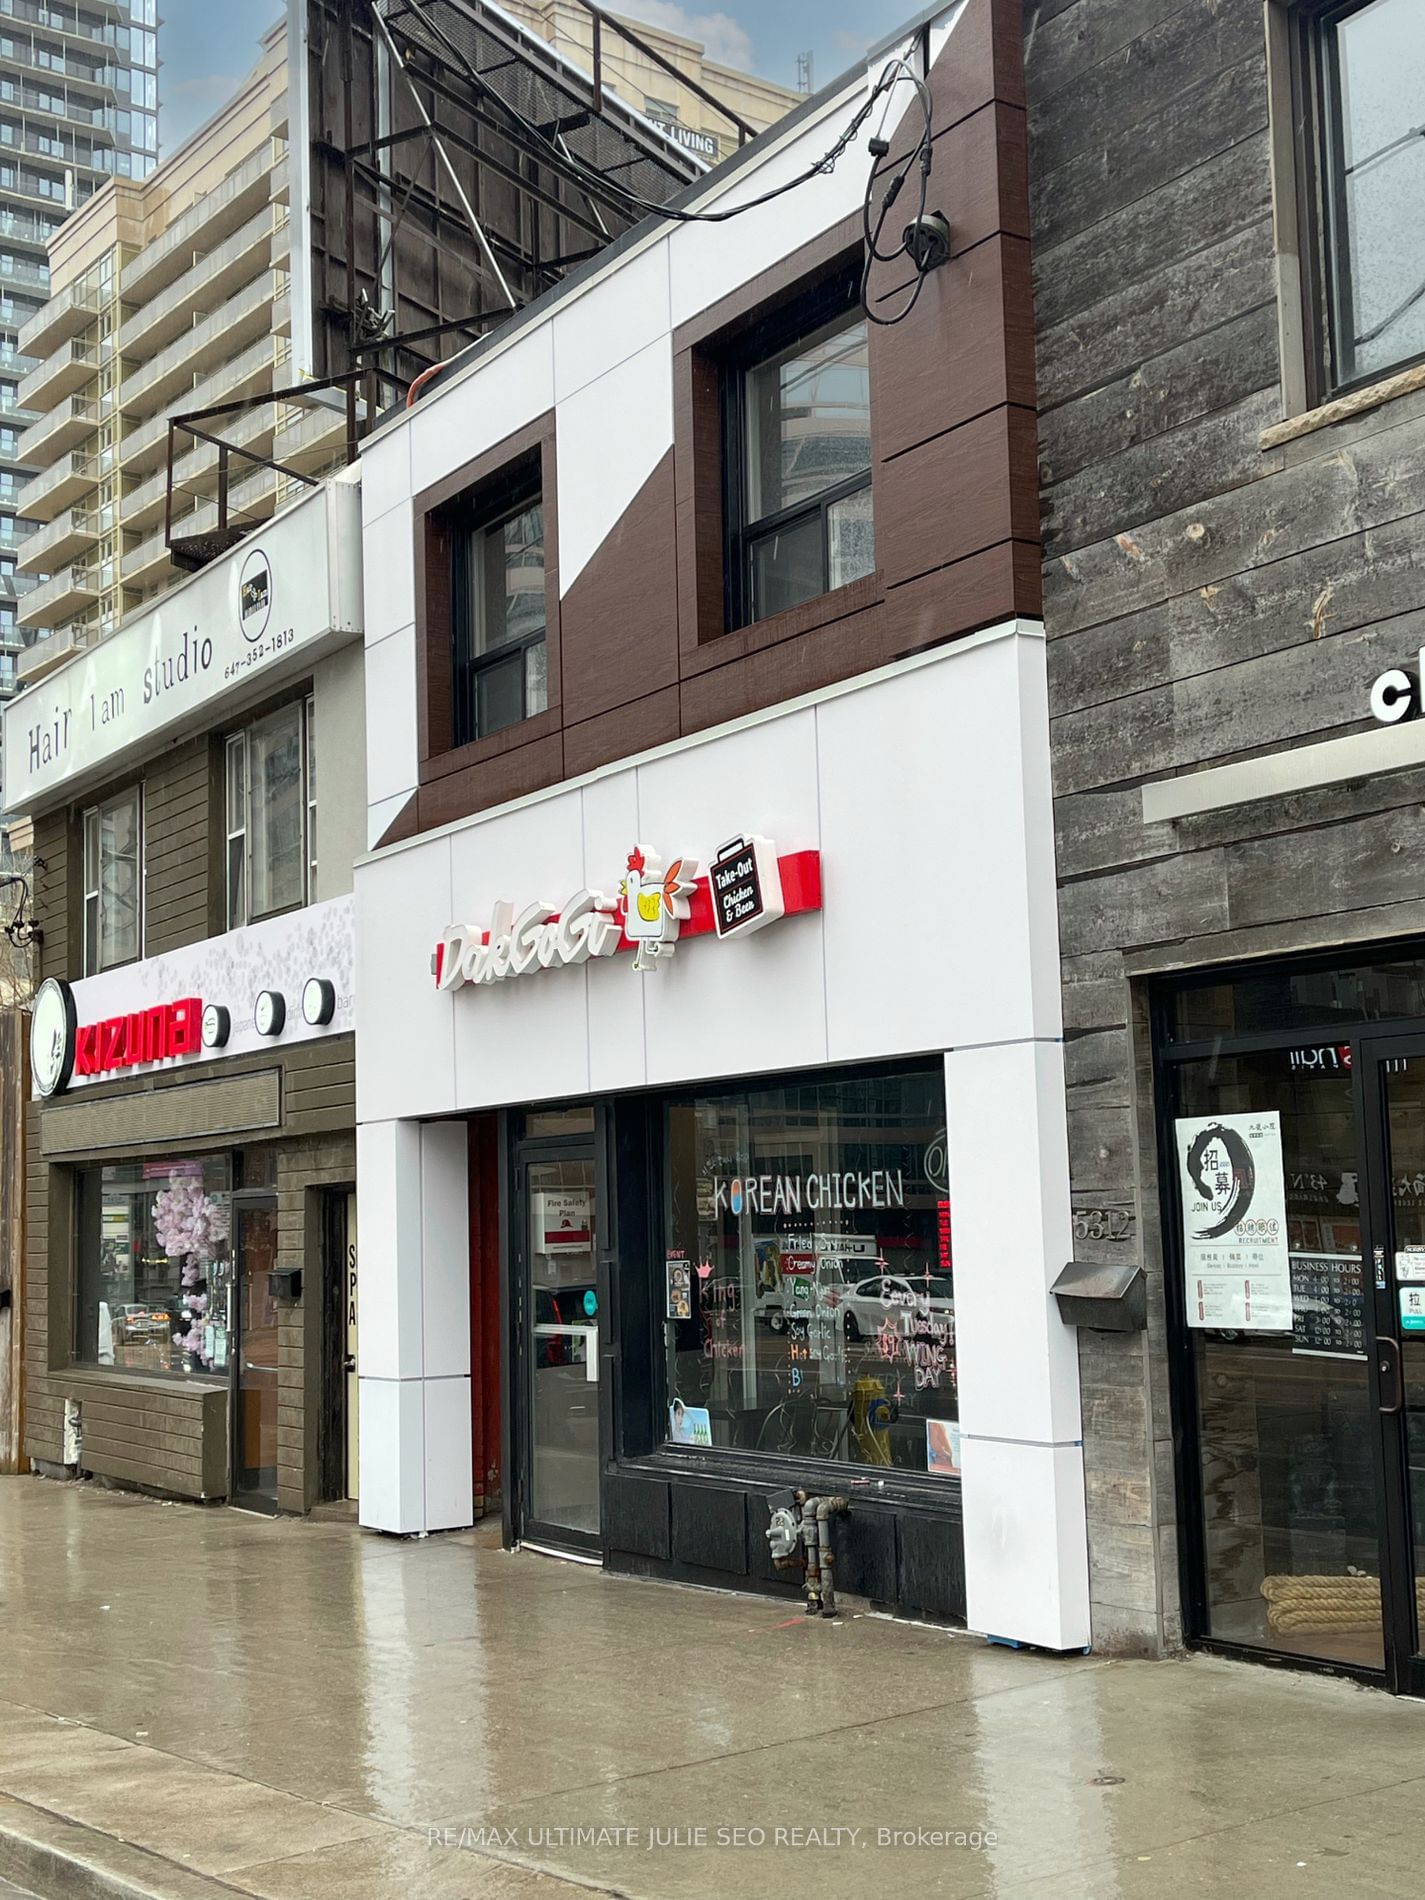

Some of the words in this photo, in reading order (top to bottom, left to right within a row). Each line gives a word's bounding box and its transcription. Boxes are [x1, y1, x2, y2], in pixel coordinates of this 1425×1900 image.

[671, 126, 714, 154] LIVING
[224, 628, 295, 680] 647-352-1813
[28, 706, 72, 774] Hair
[143, 624, 213, 705] studio
[715, 857, 753, 890] Take-Out
[723, 885, 754, 909] Chicken
[726, 909, 734, 923] &
[735, 900, 755, 918] Beer
[547, 1199, 562, 1208] Fire
[563, 1199, 586, 1209] Safety
[714, 1175, 801, 1219] KOREAN
[806, 1170, 904, 1208] CHICKEN
[559, 1209, 576, 1217] Plan
[1191, 1202, 1209, 1212] JOIN
[1211, 1202, 1222, 1212] US
[1073, 1210, 1131, 1240] 5312
[1291, 1261, 1328, 1273] BUSINESS
[1331, 1263, 1362, 1274] HOURS
[1292, 1274, 1309, 1282] MON
[348, 1243, 357, 1325] SPA
[1292, 1284, 1306, 1293] TUE
[1409, 1291, 1421, 1307] 拉
[1295, 1325, 1306, 1333] SAT
[1295, 1335, 1309, 1343] SUN
[914, 1366, 942, 1391] DAY
